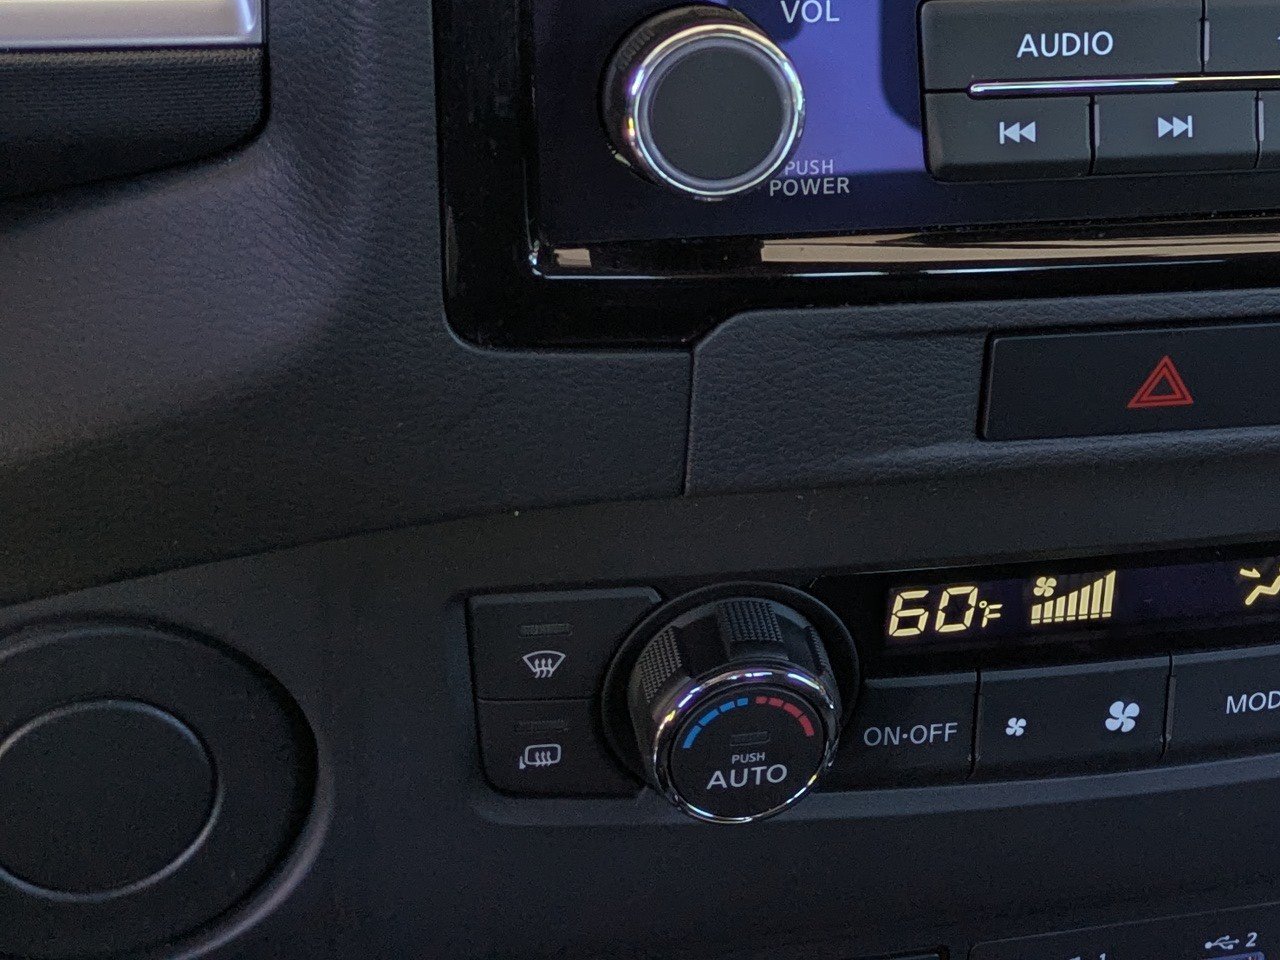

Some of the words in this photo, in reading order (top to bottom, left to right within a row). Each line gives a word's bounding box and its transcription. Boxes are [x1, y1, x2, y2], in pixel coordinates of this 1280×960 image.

[780, 0, 840, 23] VOL
[1016, 30, 1114, 58] AUDIO
[785, 159, 834, 176] PUSH
[769, 177, 850, 197] POWER
[731, 752, 765, 764] PUSH
[706, 764, 788, 790] AUTO
[1245, 932, 1258, 948] 2
